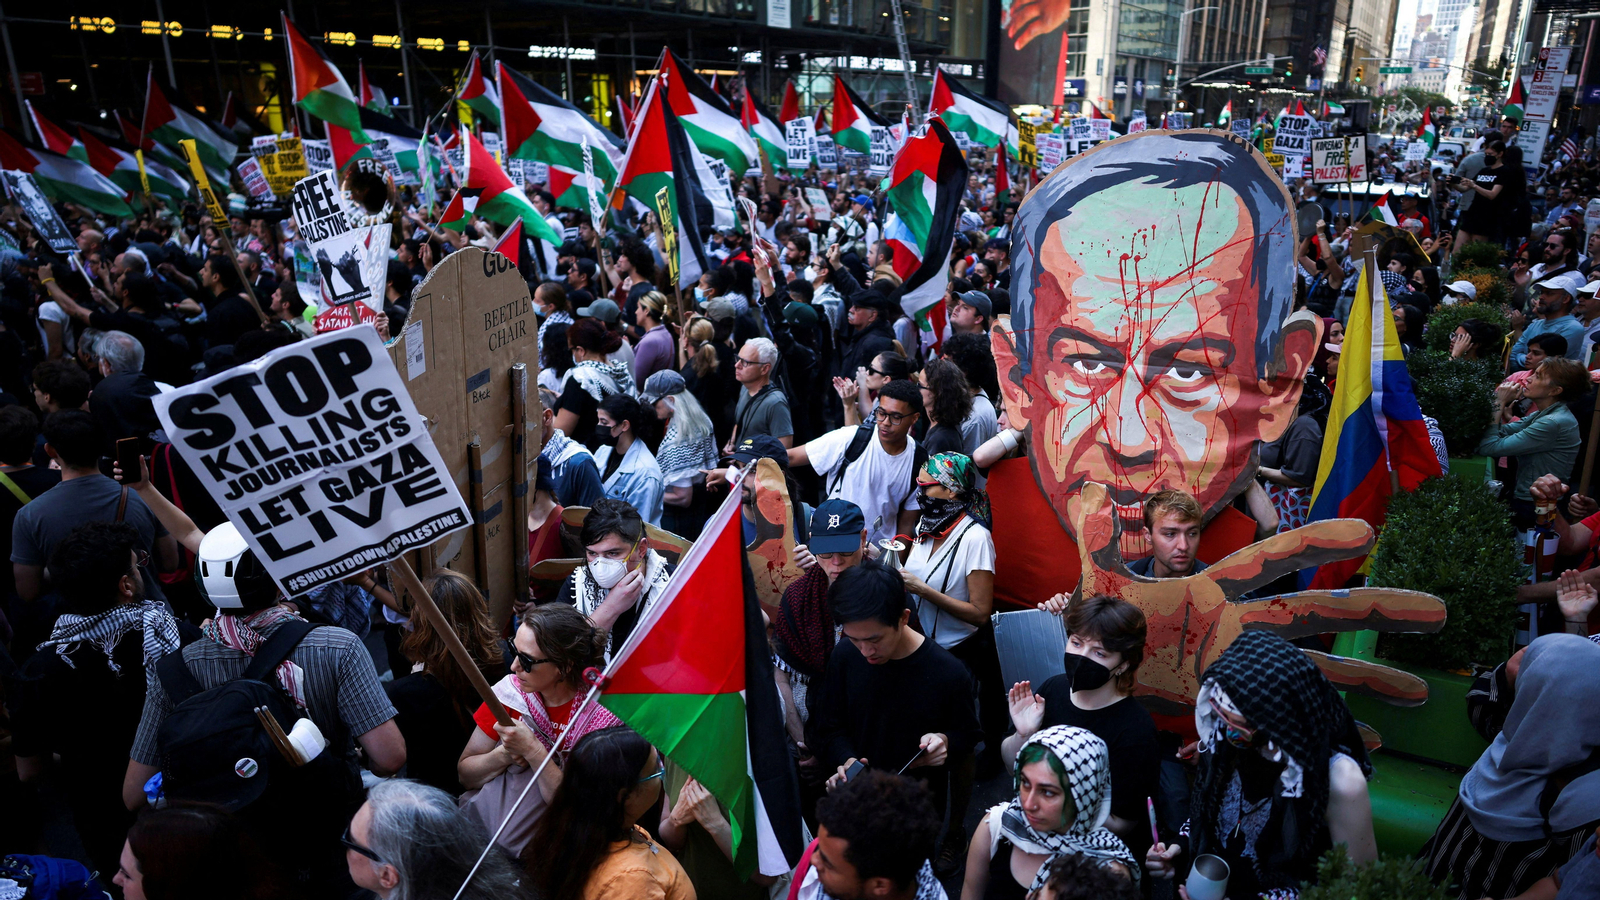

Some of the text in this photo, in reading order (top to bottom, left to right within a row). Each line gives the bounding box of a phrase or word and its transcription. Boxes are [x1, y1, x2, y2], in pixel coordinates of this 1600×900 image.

[1535, 72, 1542, 81] 3
[1073, 125, 1091, 135] STOP
[1280, 116, 1310, 130] STOP
[1522, 121, 1529, 130] 6
[788, 128, 807, 139] LET
[1278, 128, 1307, 137] STARVING
[788, 138, 807, 147] GAZA
[1066, 140, 1103, 155] LET
[1275, 135, 1304, 150] GAZA
[1352, 138, 1359, 148] A
[278, 152, 301, 165] STOP
[306, 144, 331, 162] STOP
[788, 148, 807, 160] LIVE
[358, 159, 389, 186] FREE
[294, 173, 341, 226] FREE
[301, 211, 350, 245] PALESTINE
[329, 305, 365, 318] ARRT
[483, 296, 529, 332] BEETLE
[488, 319, 527, 352] CHAIR
[168, 337, 373, 451] STOP
[472, 388, 491, 404] BACK
[199, 387, 402, 483] KILLING
[224, 415, 411, 501] JOURNALISTS
[237, 442, 432, 536] LET GAZA
[255, 466, 449, 562] LIVE
[288, 512, 462, 592] #SHUTITDOWN4PALESTINE
